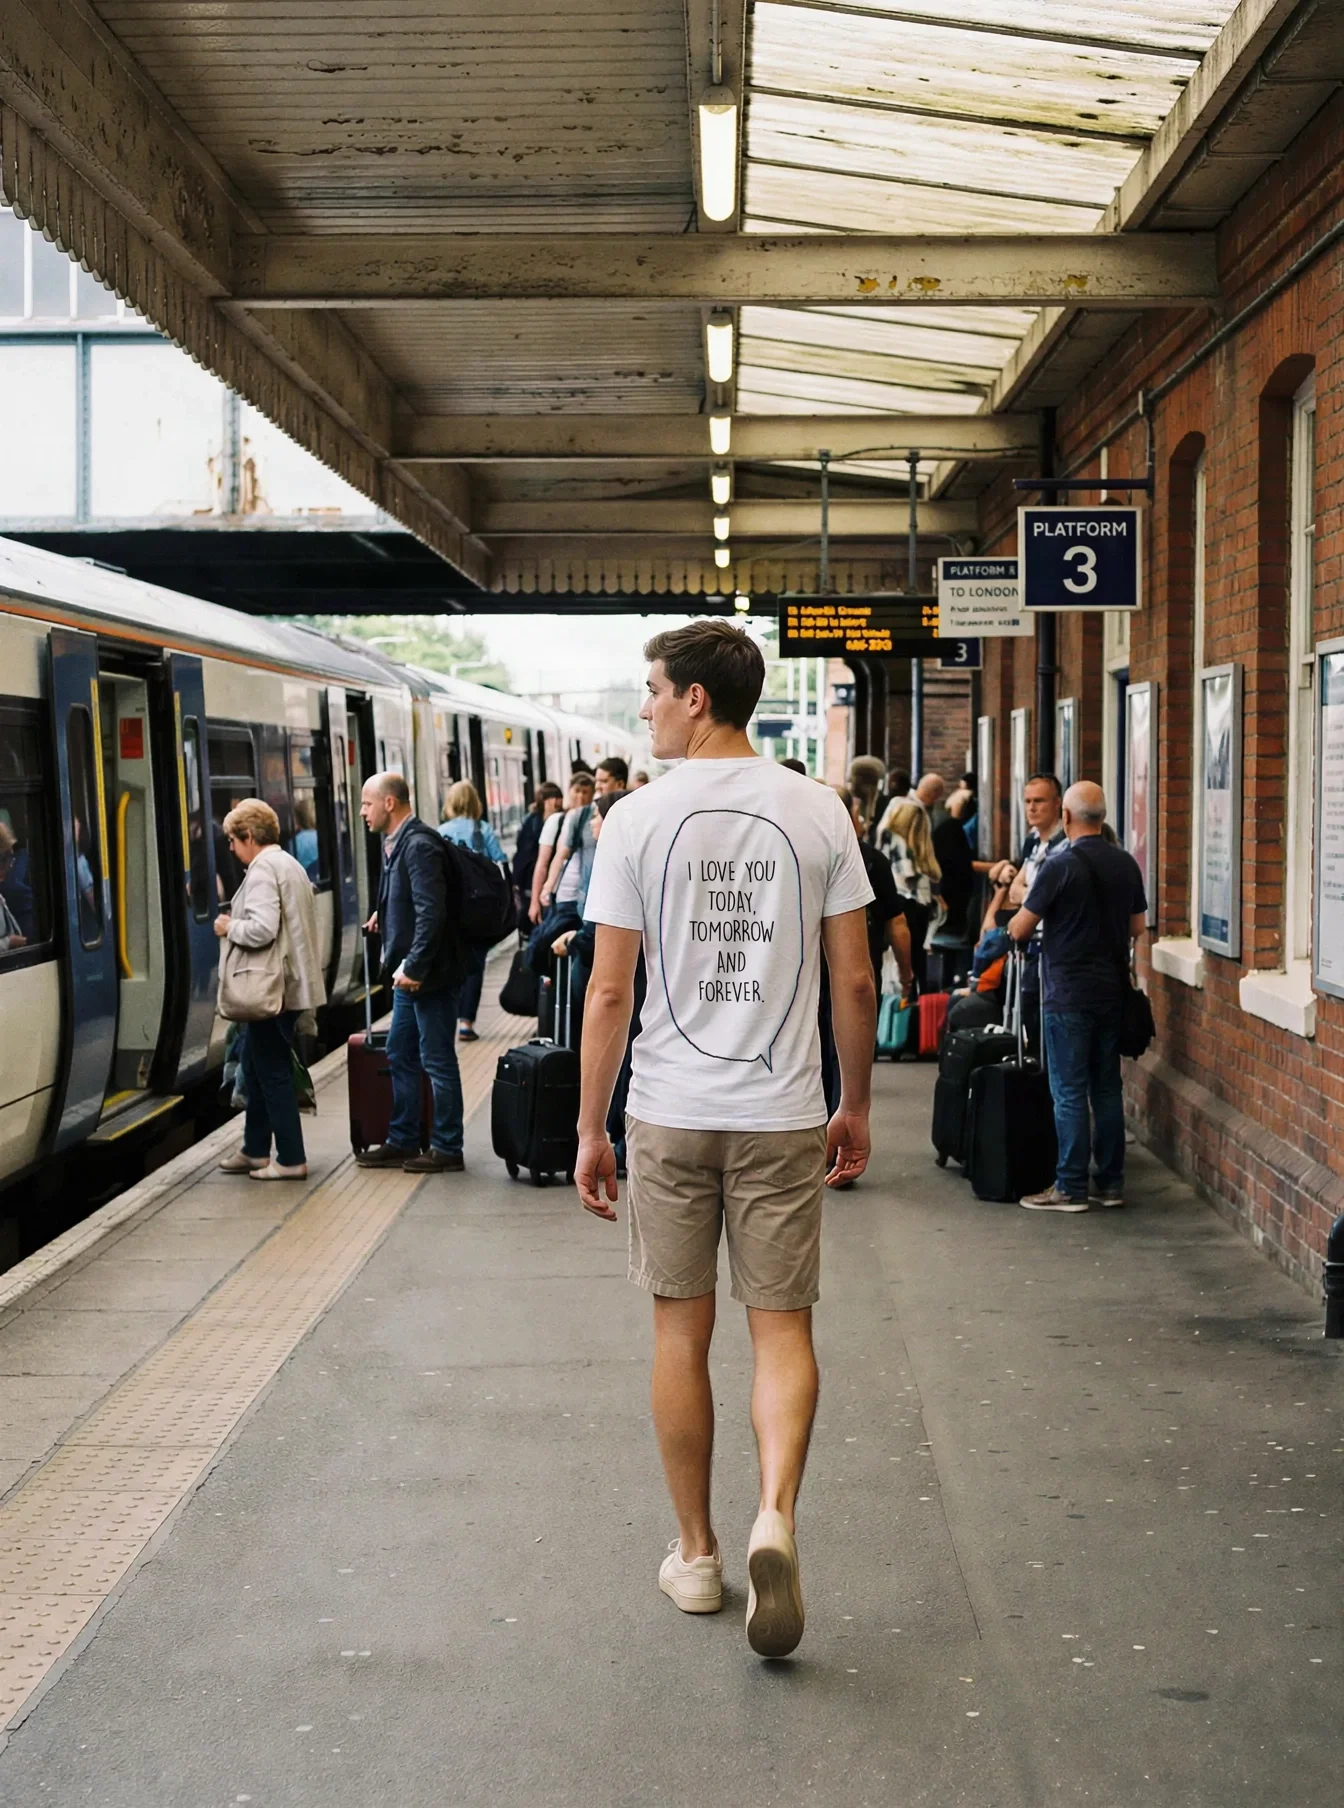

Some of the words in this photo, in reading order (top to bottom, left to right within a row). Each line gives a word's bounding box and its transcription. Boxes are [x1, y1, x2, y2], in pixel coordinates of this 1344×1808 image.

[1033, 522, 1127, 537] PLATFORM
[950, 566, 1005, 575] PLATFORM
[1063, 545, 1097, 593] 3
[950, 587, 965, 597] TO
[954, 642, 968, 662] 3
[688, 861, 691, 881] I
[701, 860, 735, 882] LOVE
[745, 860, 775, 882] YOU
[708, 890, 756, 916] TODAY,
[689, 920, 774, 942] TOMORROW
[717, 950, 746, 973] AND
[699, 980, 765, 1003] FOREVER.
